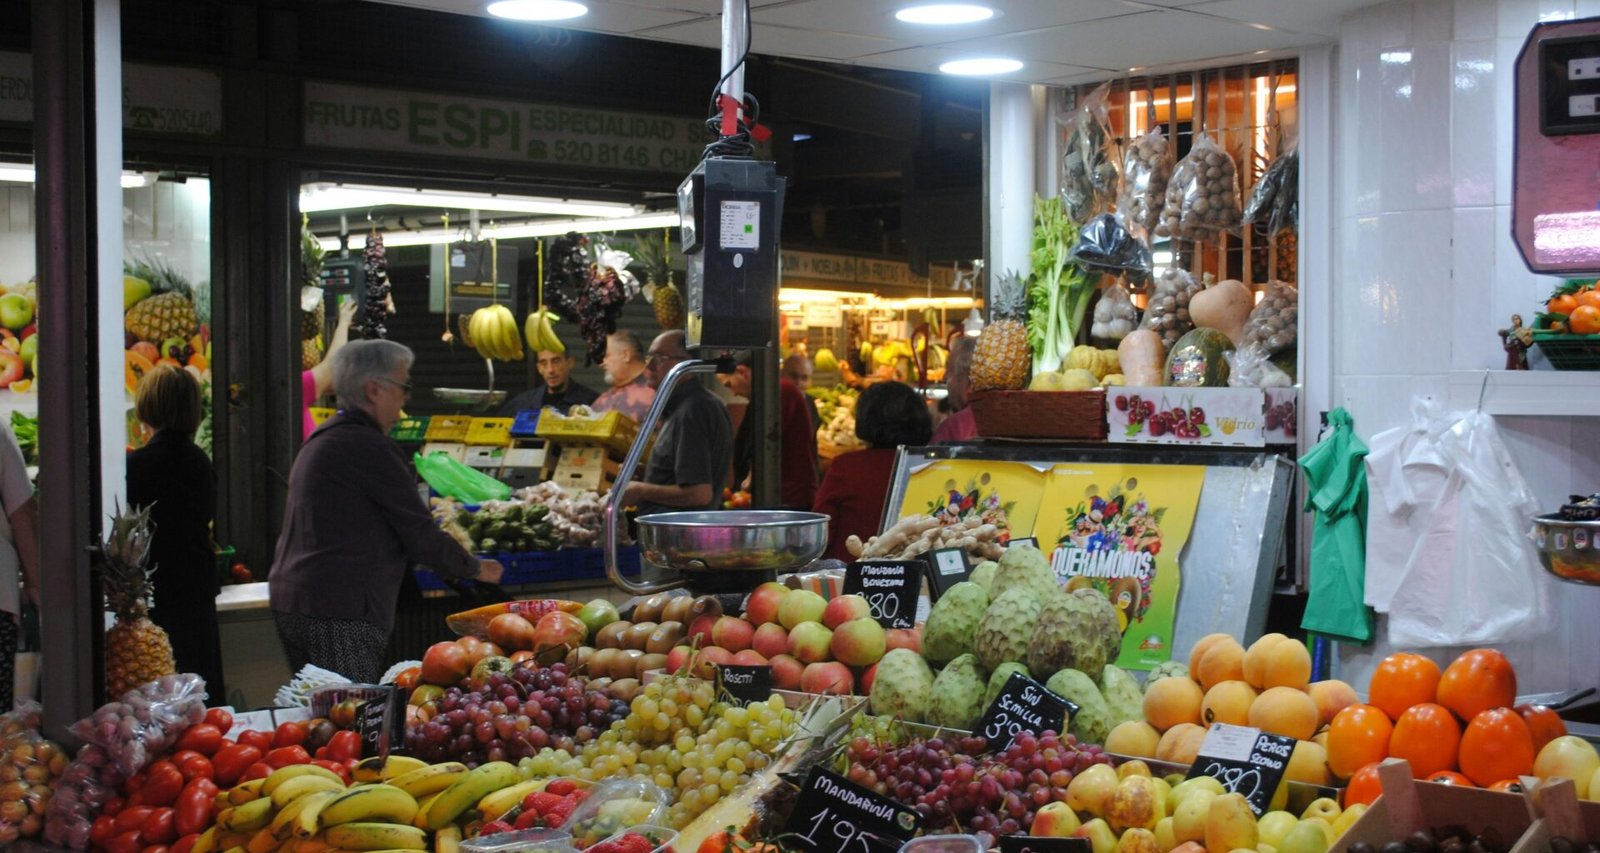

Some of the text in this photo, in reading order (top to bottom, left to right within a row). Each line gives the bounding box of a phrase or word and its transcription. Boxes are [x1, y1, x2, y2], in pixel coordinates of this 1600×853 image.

[308, 101, 401, 130] FRUTAS
[408, 99, 521, 151] ESPI
[529, 108, 673, 140] ESPECIALIDAD
[554, 140, 593, 161] 520
[598, 143, 649, 166] 8146
[1215, 416, 1256, 431] Vidrio
[1052, 541, 1151, 580] QUERÁMONOS
[997, 693, 1043, 726] SEMILLA
[1020, 685, 1043, 706] SIN
[813, 775, 896, 822] MANDARINA
